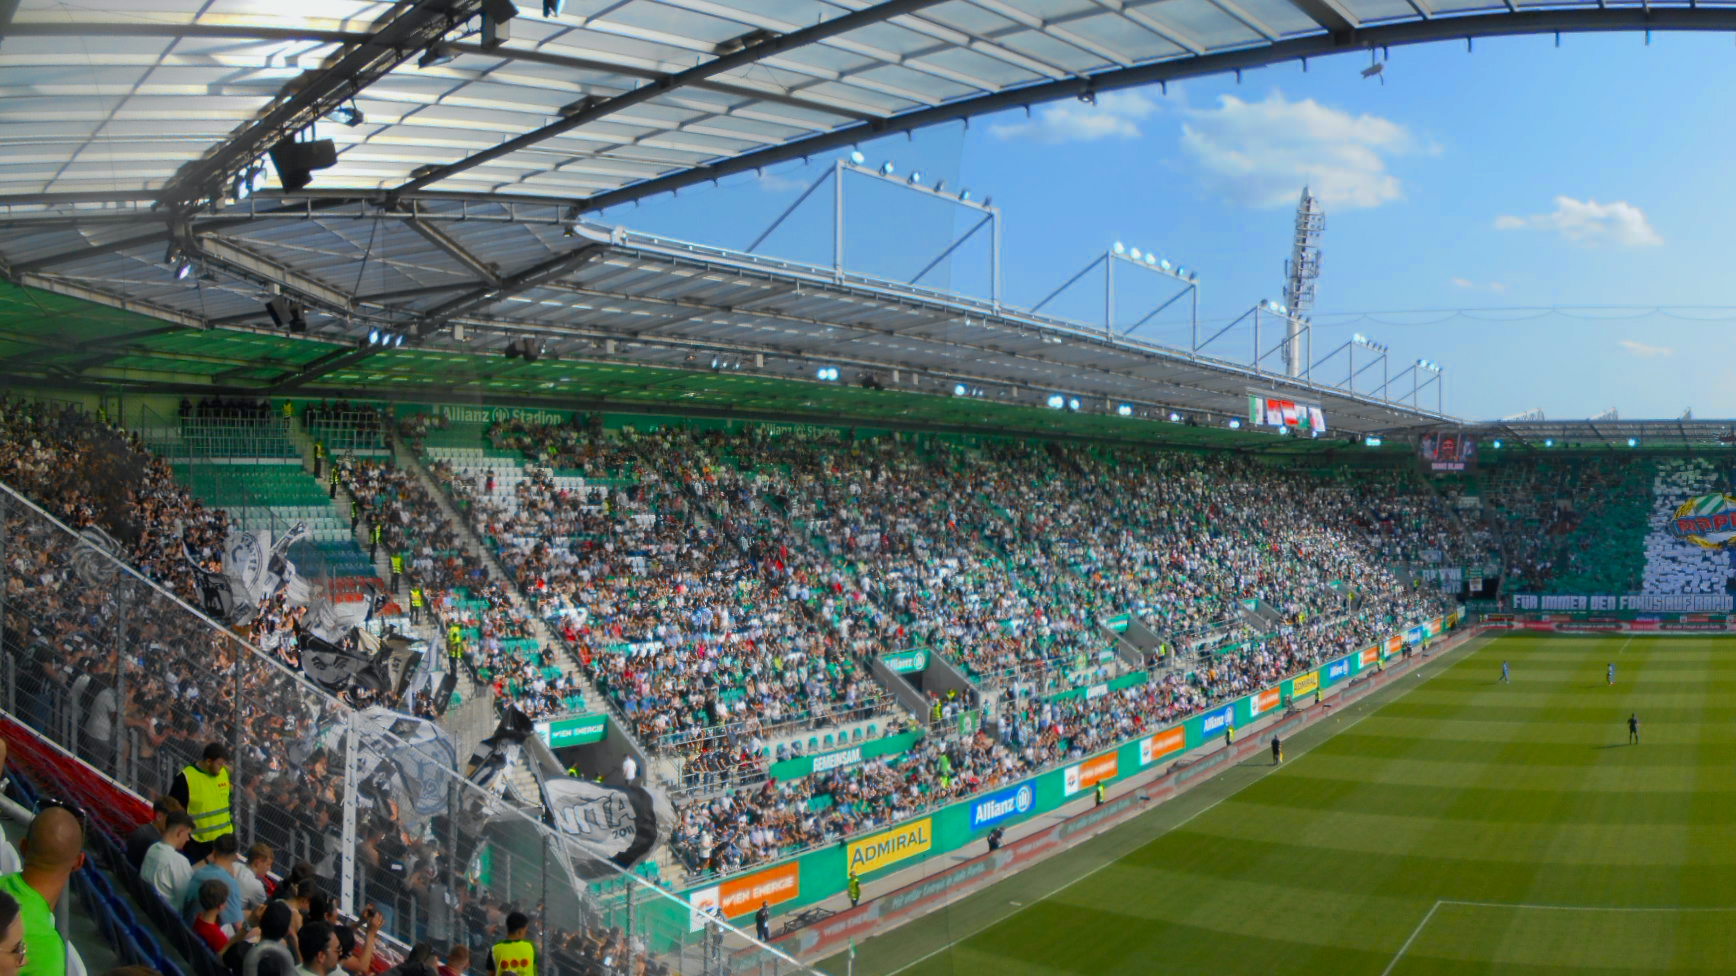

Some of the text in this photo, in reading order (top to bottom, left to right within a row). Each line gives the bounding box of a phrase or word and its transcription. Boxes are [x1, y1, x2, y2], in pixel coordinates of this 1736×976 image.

[443, 406, 562, 425] Allianz Stadion
[1513, 594, 1538, 610] FÜR
[975, 797, 1015, 824] Allianz
[850, 827, 928, 868] ADMIRAL
[722, 875, 796, 906] WIEN ENERGIE
